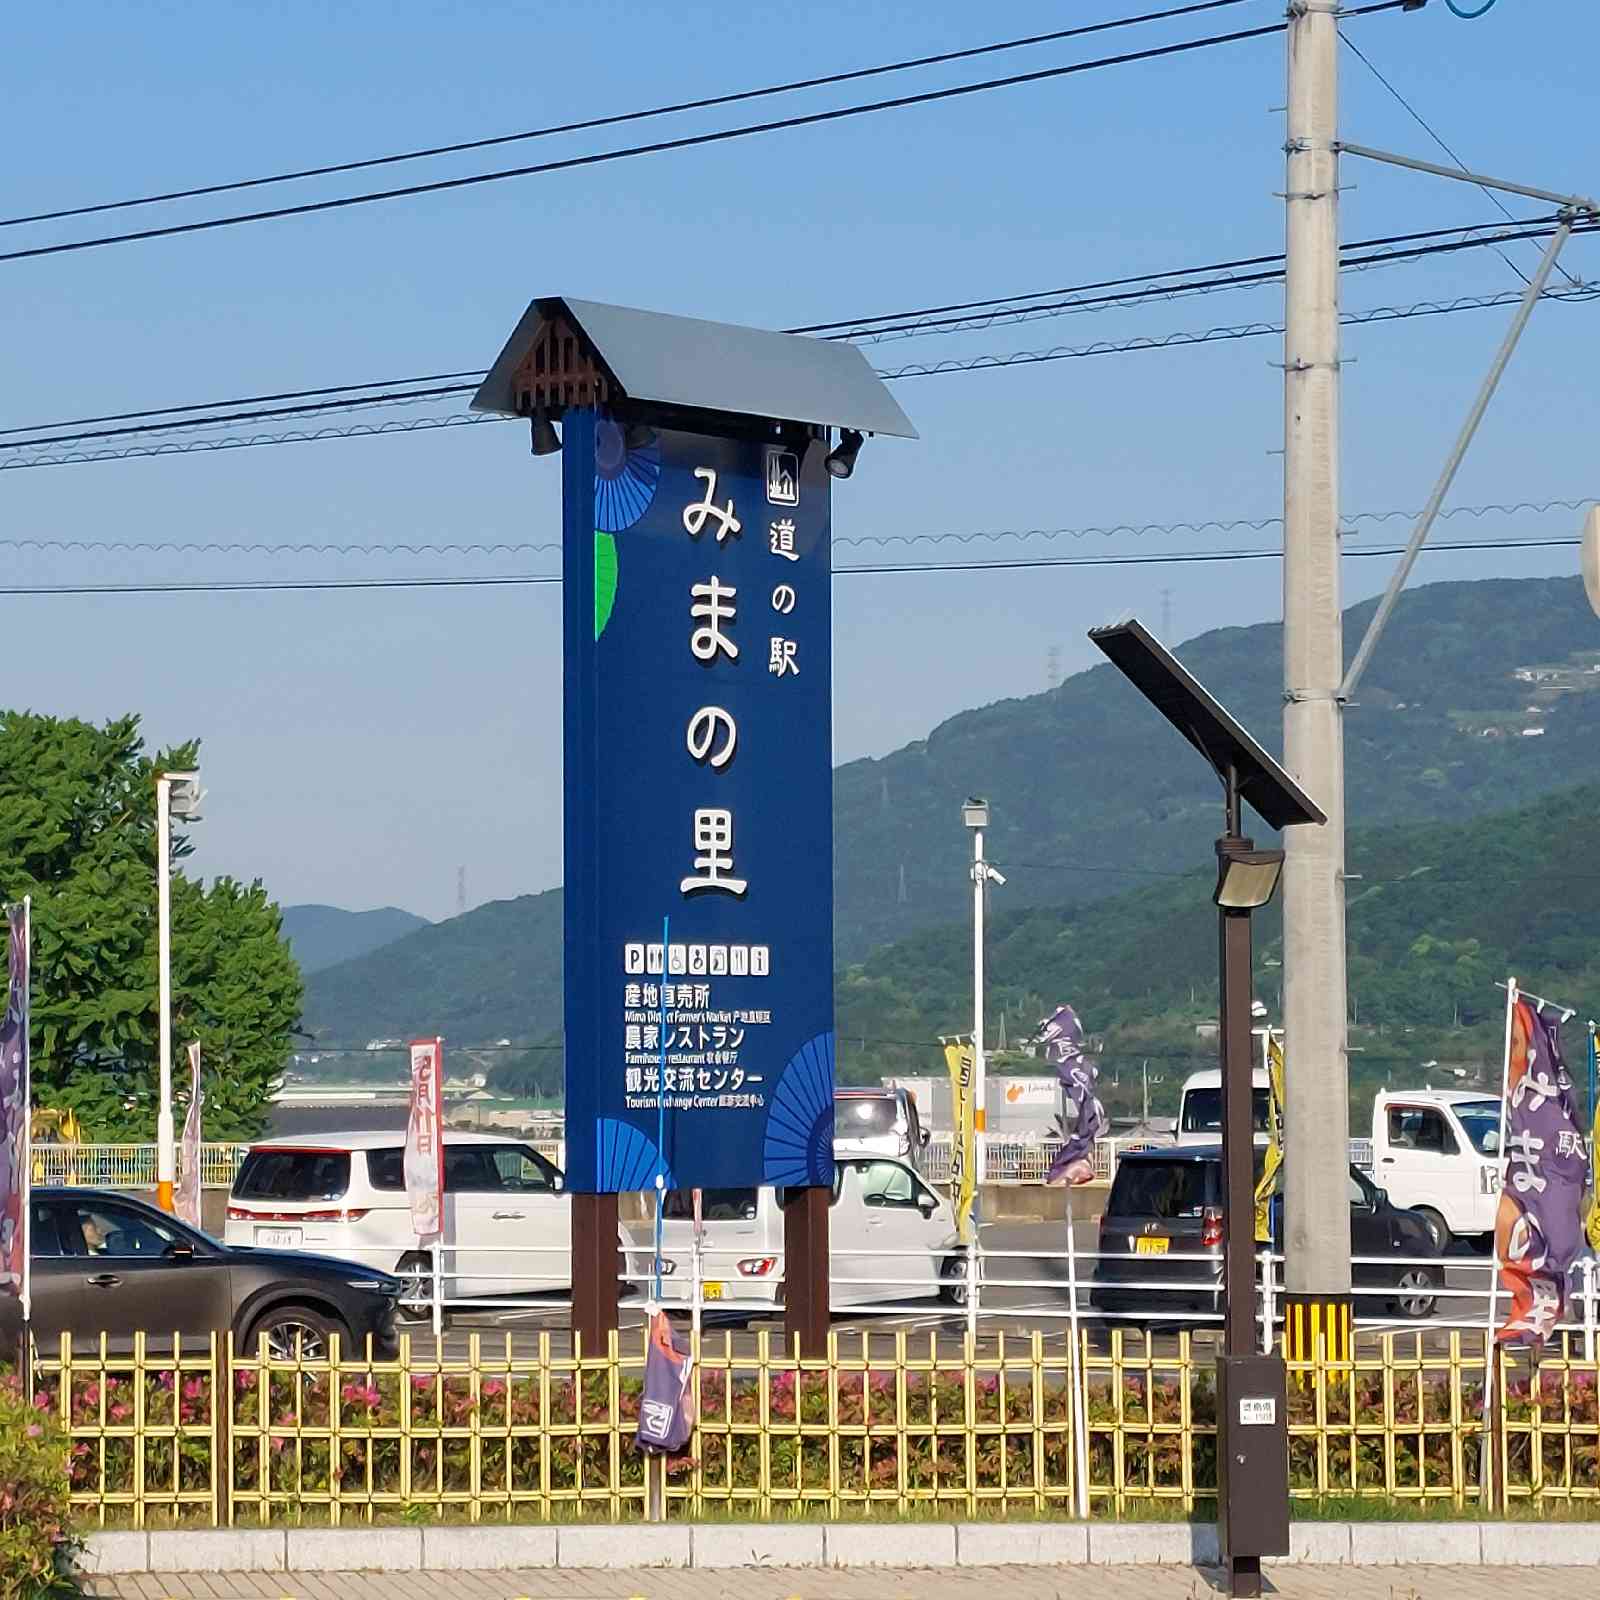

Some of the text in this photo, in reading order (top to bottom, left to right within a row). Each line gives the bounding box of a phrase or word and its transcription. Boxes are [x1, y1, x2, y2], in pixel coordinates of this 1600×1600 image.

[769, 518, 800, 677] 道の駅
[681, 466, 748, 895] みまの里
[624, 983, 710, 1009] 産地直売所
[625, 1011, 646, 1023] Mima
[647, 1011, 674, 1024] Distct
[625, 1067, 763, 1092] 観光交流センター
[625, 1095, 718, 1110] Tourism Echange Center
